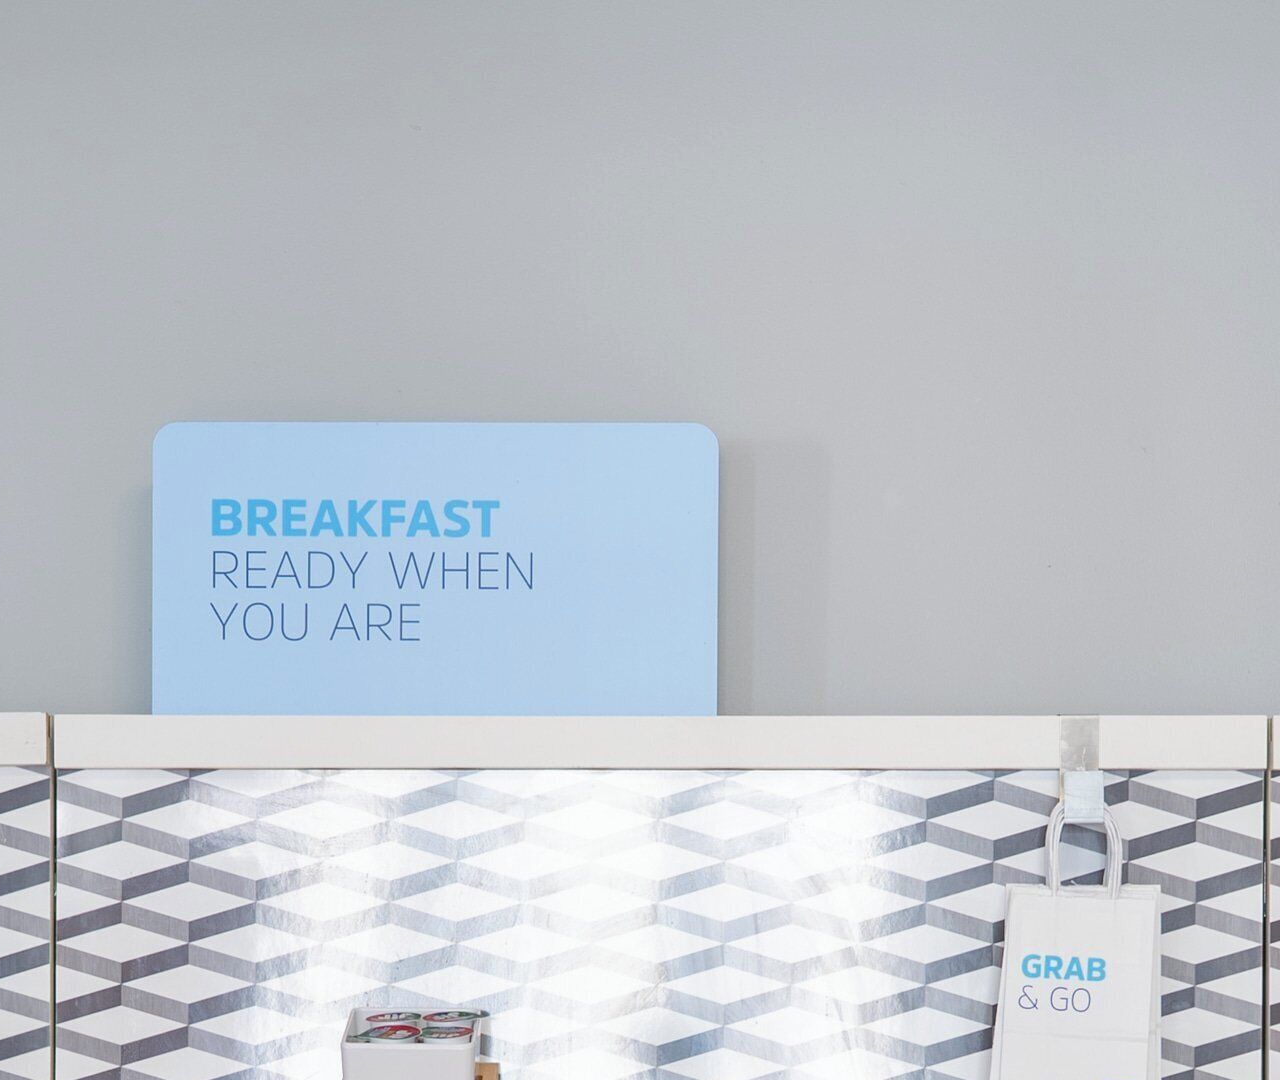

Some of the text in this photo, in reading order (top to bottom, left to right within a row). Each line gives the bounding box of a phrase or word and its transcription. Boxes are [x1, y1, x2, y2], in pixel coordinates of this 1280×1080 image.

[211, 498, 501, 538] BREAKFAST
[212, 550, 534, 590] READY WHEN
[209, 602, 421, 642] YOU ARE
[1021, 953, 1107, 982] GRAB
[1017, 984, 1092, 1013] & GO
